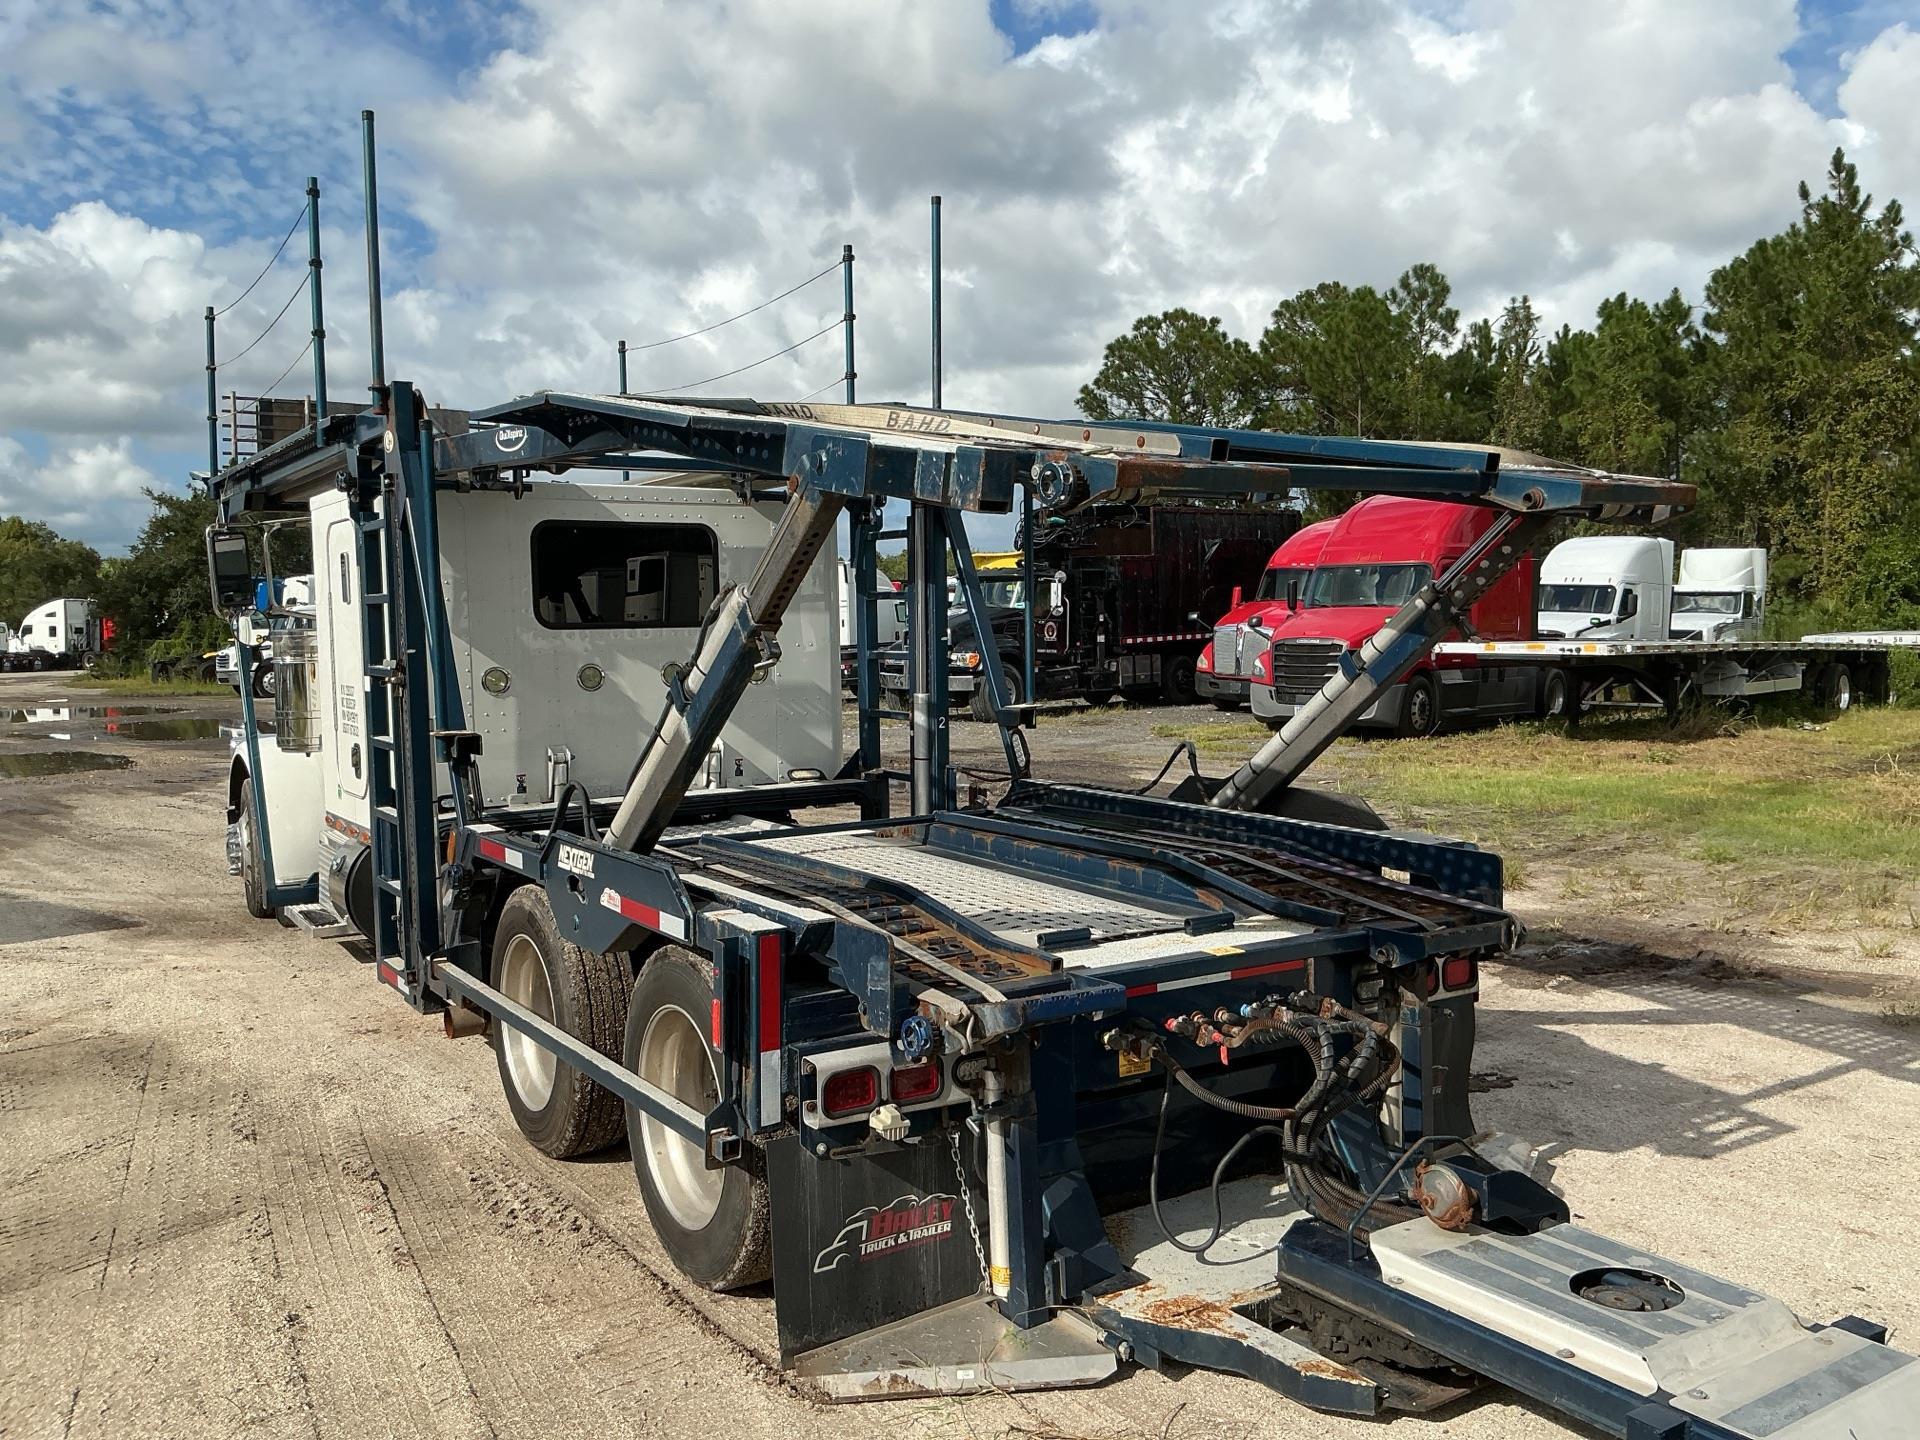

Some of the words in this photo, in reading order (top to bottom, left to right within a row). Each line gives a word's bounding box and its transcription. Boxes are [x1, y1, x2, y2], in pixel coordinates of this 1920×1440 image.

[939, 716, 945, 728] 2
[558, 844, 595, 872] NEXTGEN
[859, 1234, 896, 1256] TRUCK
[898, 1232, 908, 1244] &
[907, 1220, 952, 1241] TRAILER
